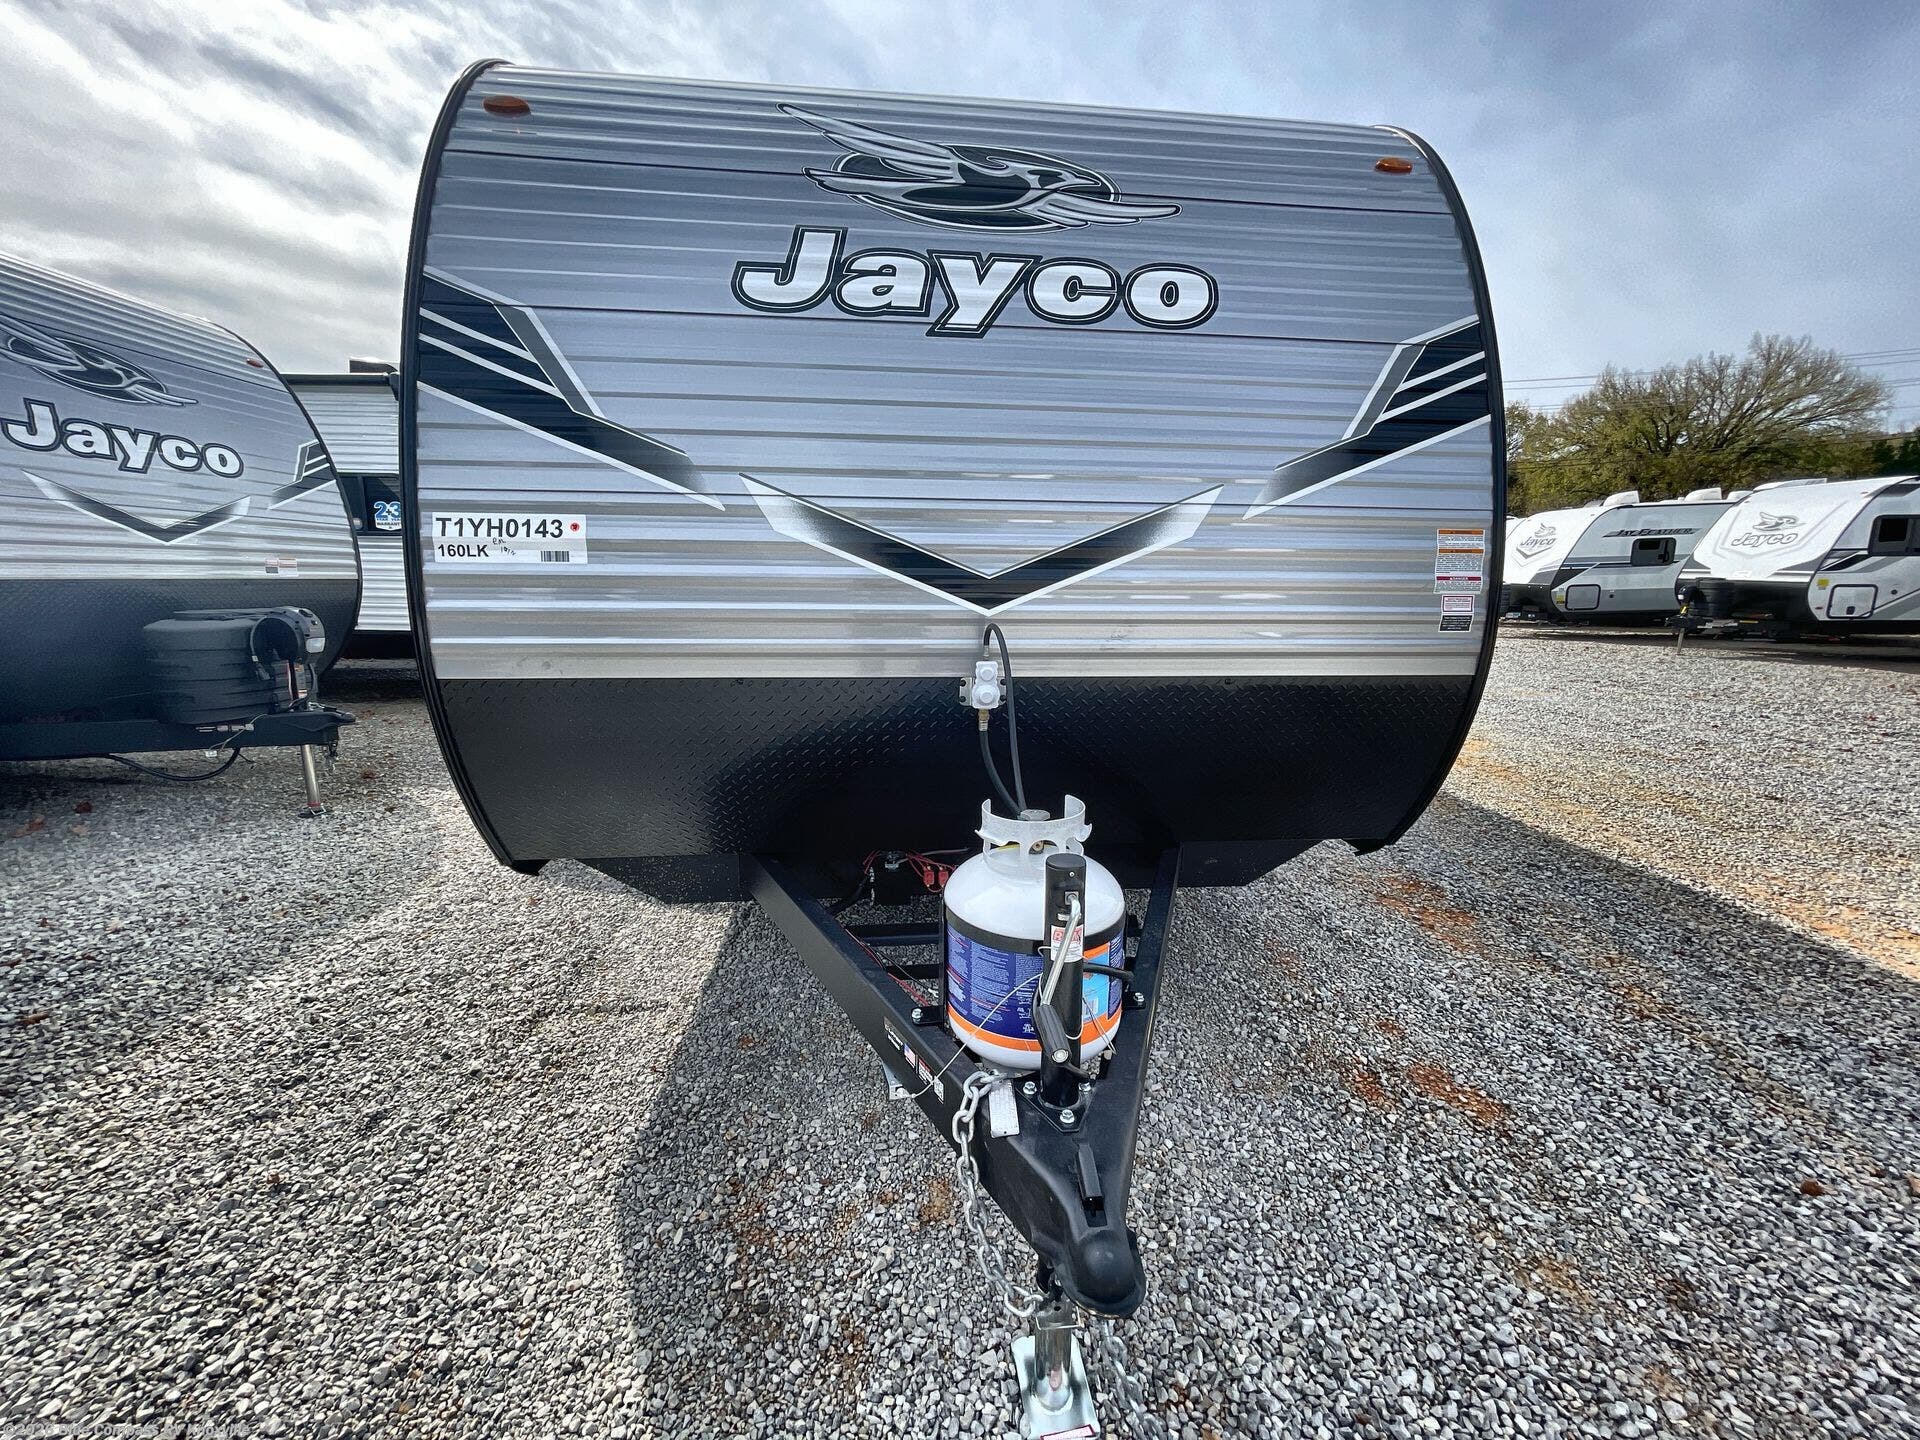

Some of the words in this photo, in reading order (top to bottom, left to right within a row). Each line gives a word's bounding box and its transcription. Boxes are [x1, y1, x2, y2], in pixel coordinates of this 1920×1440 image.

[731, 225, 1219, 338] Jayco
[0, 398, 244, 478] Jayco
[435, 517, 564, 539] T1YH0143
[1519, 536, 1557, 548] Jayco
[1731, 532, 1799, 548] Jayco
[438, 544, 489, 558] 160LK
